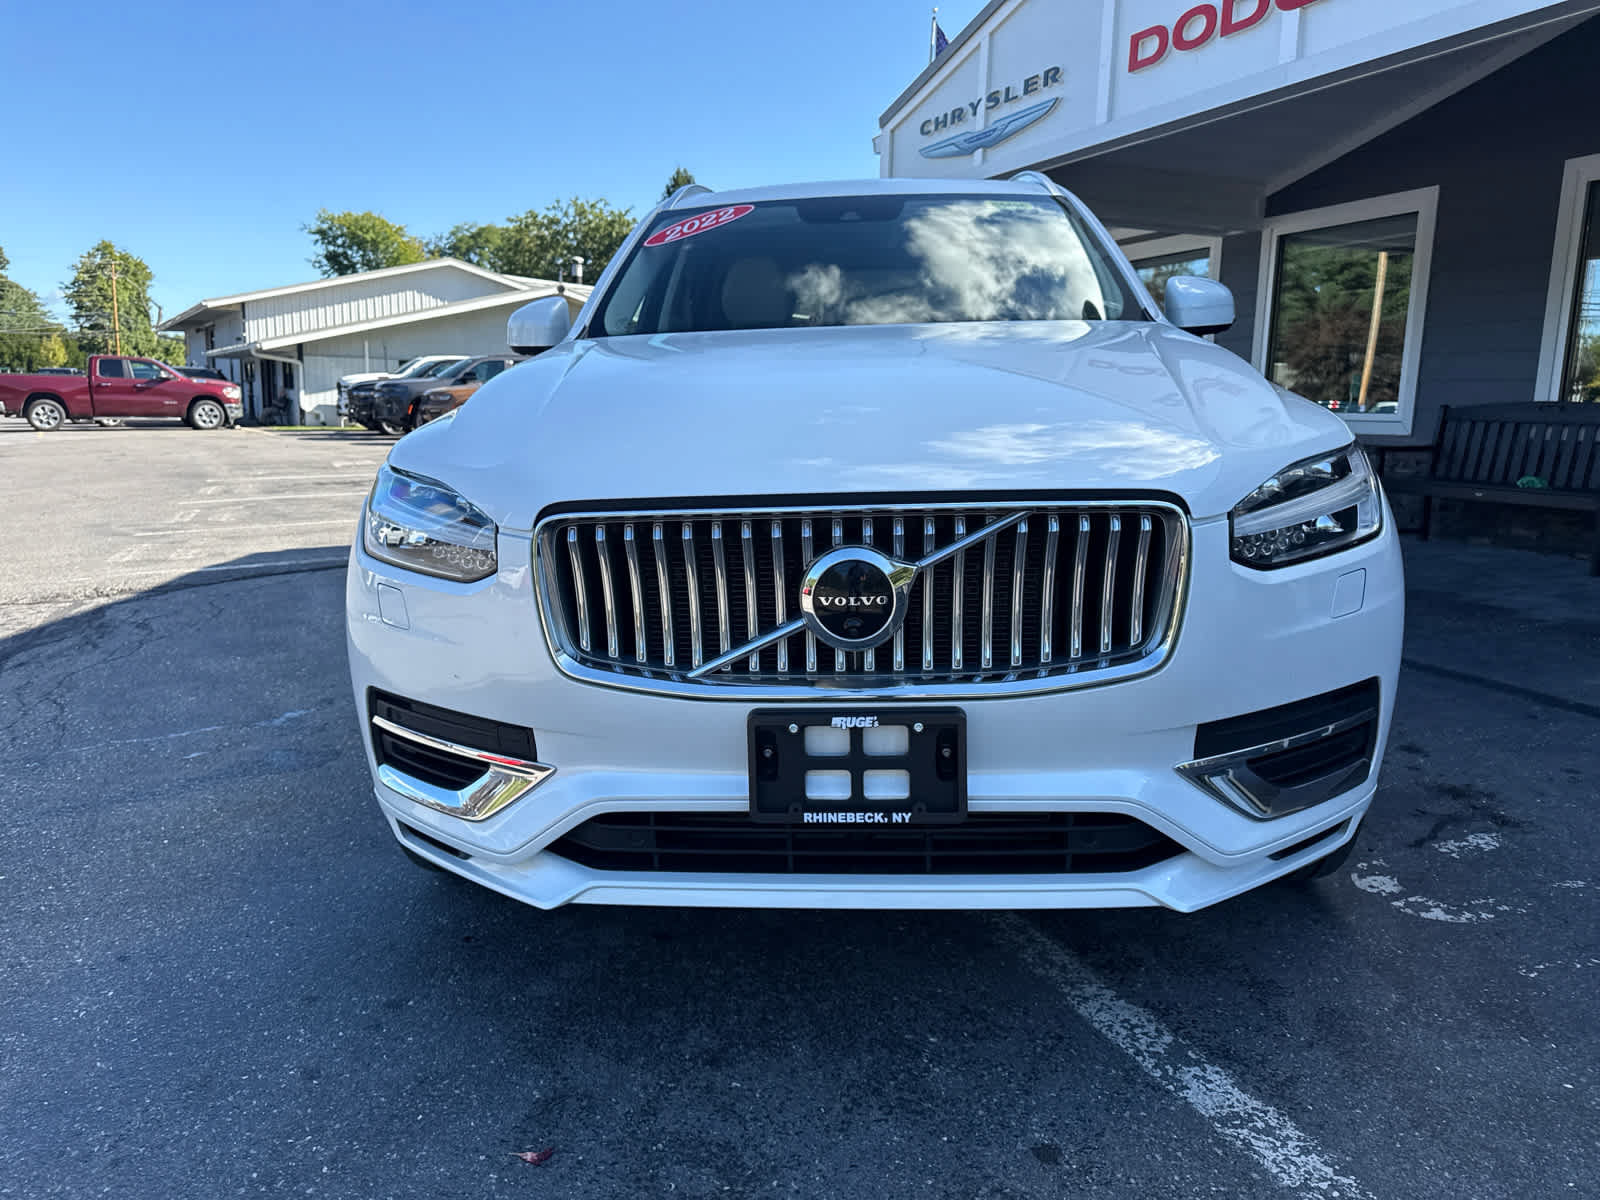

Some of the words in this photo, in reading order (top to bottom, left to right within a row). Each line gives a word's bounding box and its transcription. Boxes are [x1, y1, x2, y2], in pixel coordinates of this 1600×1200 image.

[1128, 0, 1322, 73] DOD
[920, 66, 1062, 136] CHRYSLER
[664, 208, 735, 242] 2022
[818, 595, 889, 607] VOLVO
[803, 812, 888, 824] RHINEBECK,
[892, 812, 912, 823] NY
